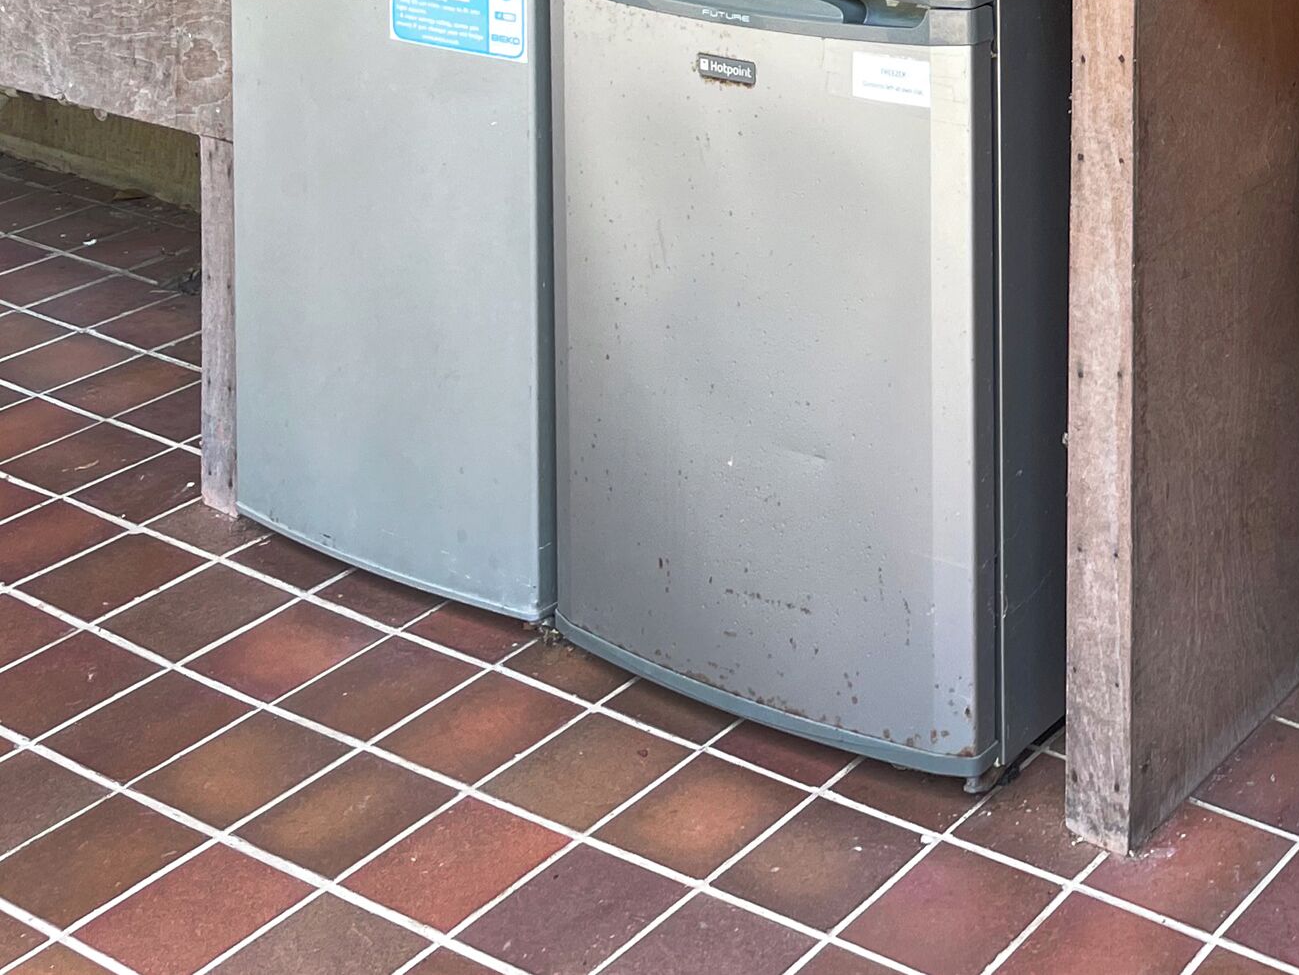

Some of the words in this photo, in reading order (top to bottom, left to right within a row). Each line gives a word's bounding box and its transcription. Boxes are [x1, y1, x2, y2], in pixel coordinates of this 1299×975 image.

[702, 9, 750, 22] FUTURE
[492, 34, 520, 45] BEKO
[710, 60, 752, 78] Hotpoint
